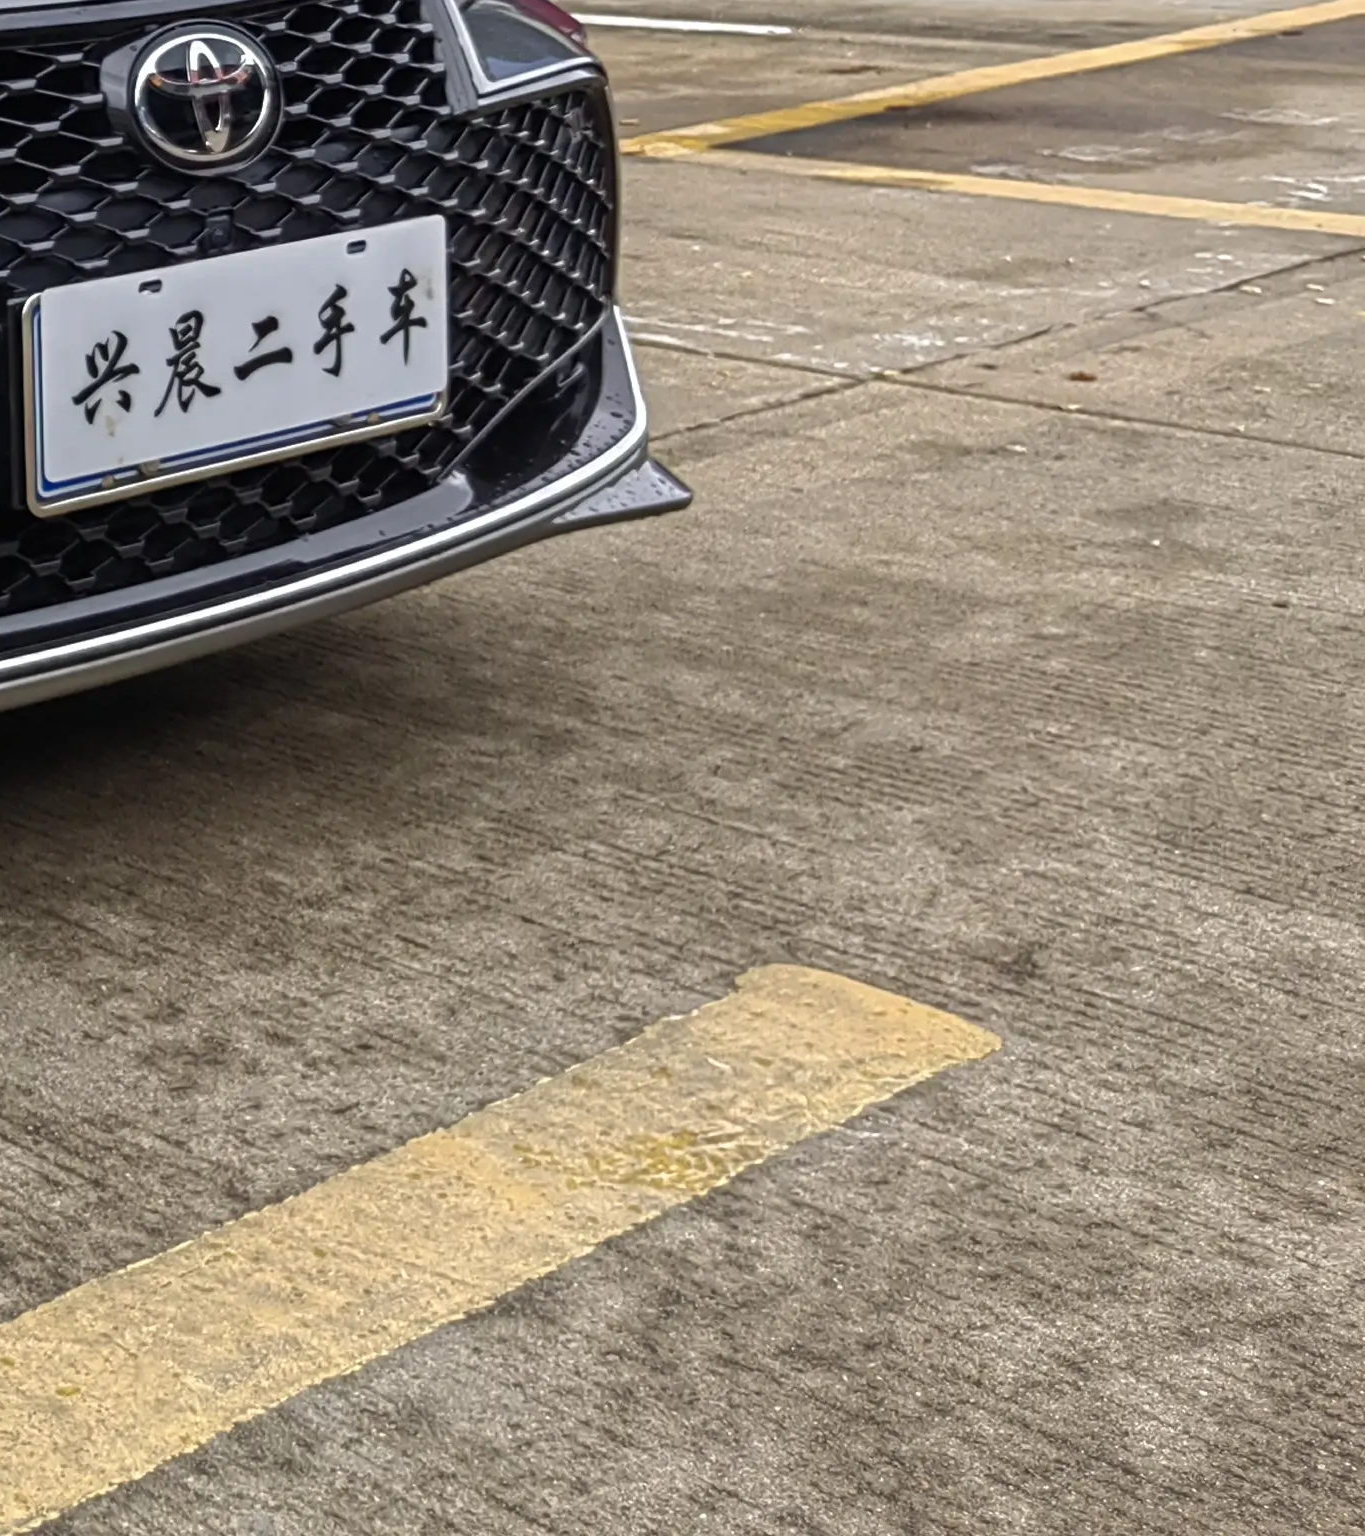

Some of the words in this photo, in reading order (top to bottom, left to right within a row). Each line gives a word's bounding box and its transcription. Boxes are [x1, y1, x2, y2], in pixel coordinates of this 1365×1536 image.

[71, 267, 429, 425] 兴晨二手车
